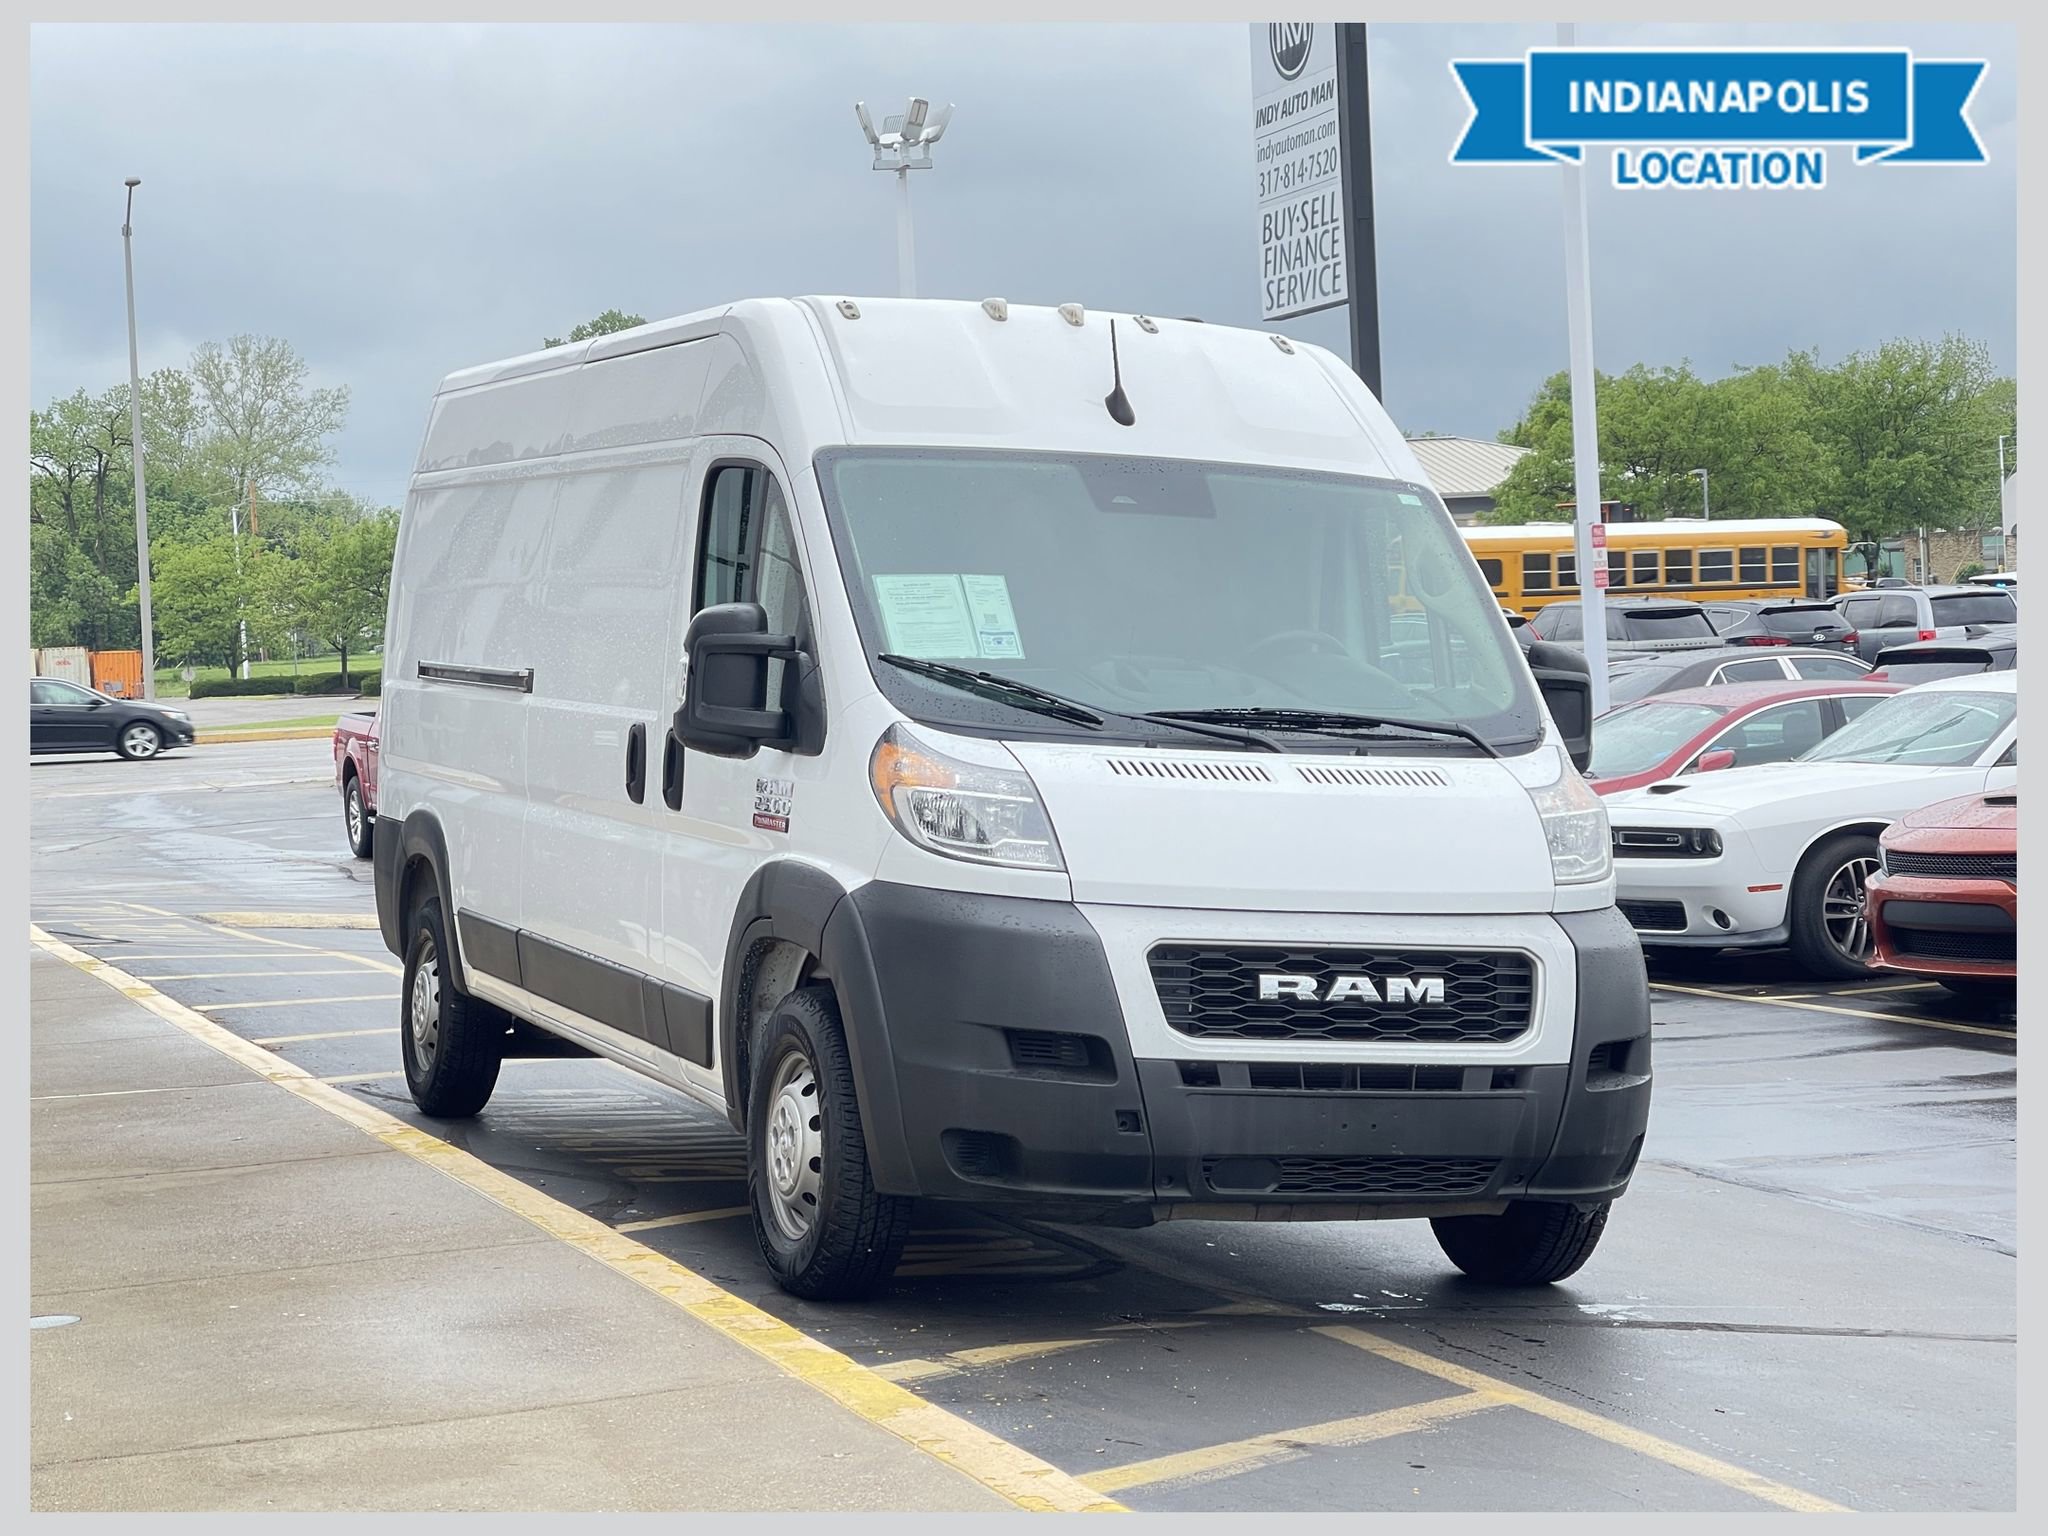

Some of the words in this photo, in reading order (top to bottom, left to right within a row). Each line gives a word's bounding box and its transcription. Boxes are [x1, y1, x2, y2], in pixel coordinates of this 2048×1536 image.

[1255, 101, 1280, 129] INDY
[1281, 90, 1309, 120] AUTO
[1310, 78, 1335, 108] MAN
[1257, 120, 1336, 164] indyautoman.com
[1264, 226, 1340, 279] FINANCE
[1266, 261, 1342, 312] SERVICE
[1259, 974, 1445, 1003] RAM
